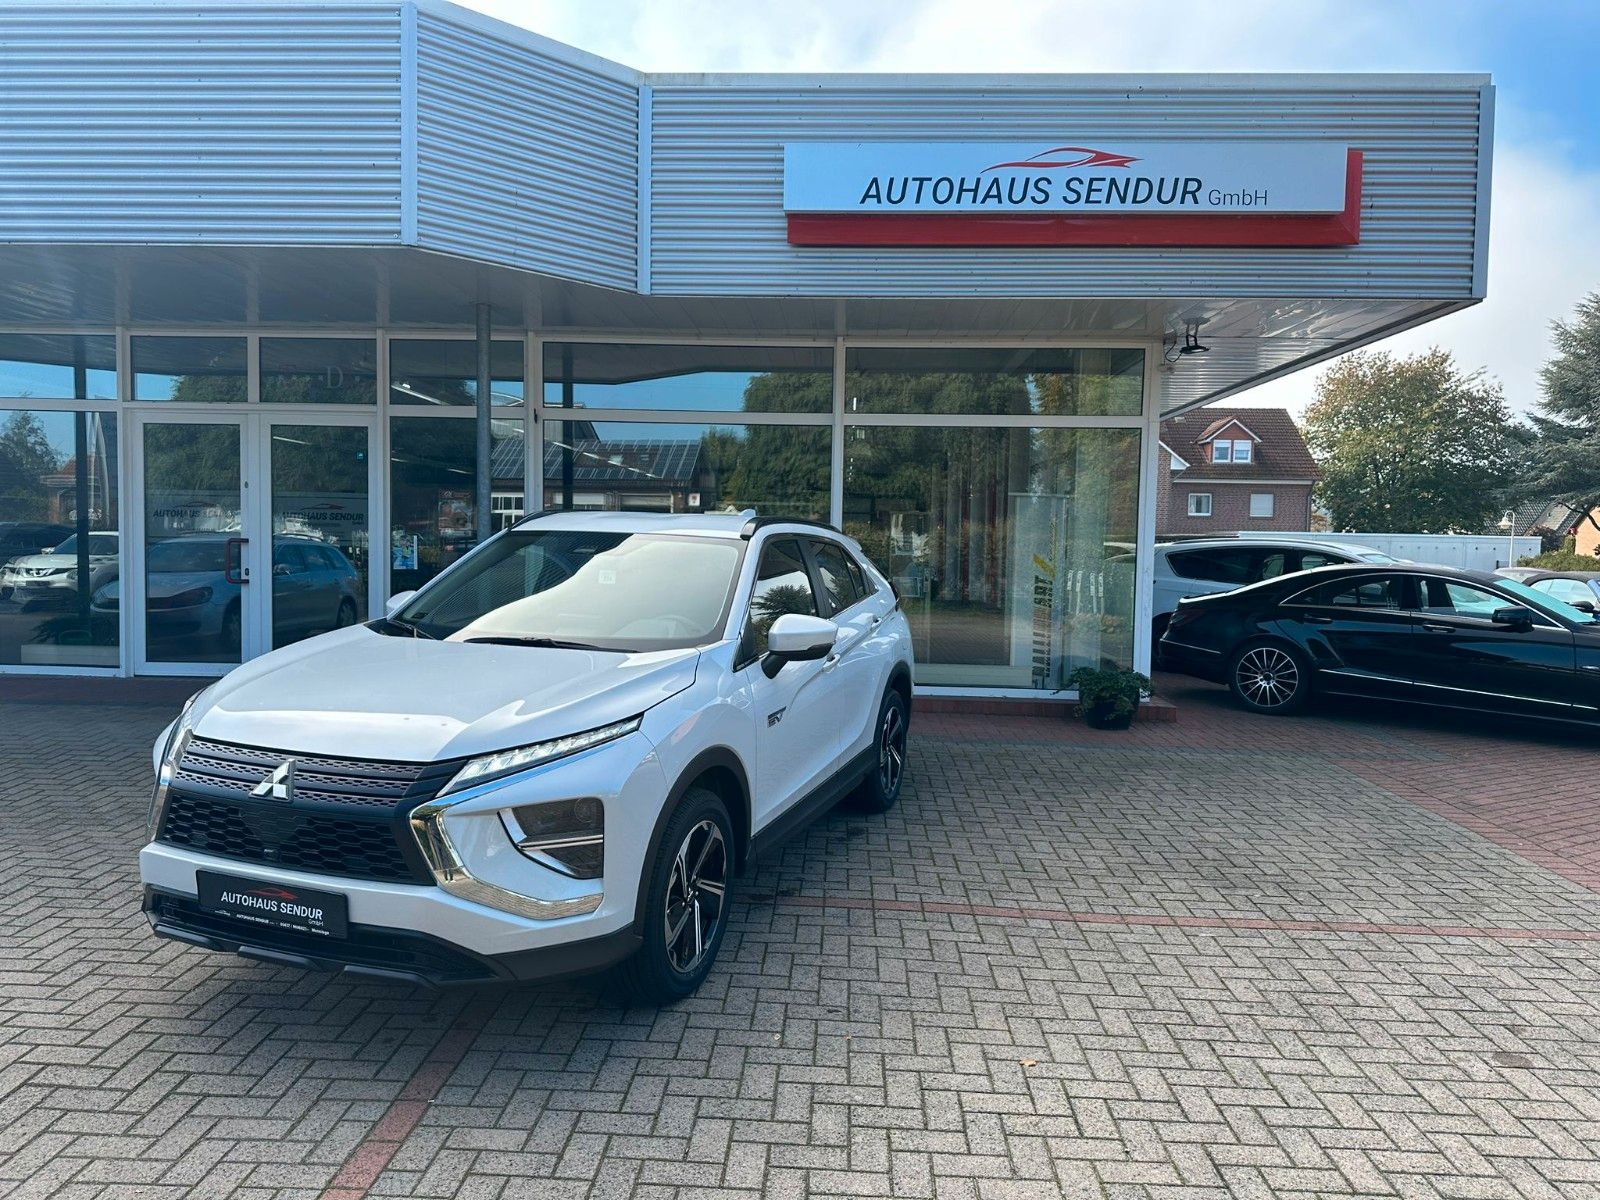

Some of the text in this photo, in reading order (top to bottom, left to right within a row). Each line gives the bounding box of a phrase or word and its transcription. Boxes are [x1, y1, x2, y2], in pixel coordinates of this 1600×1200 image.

[860, 177, 1268, 206] AUTOHAUS SENDUR GmbH
[329, 512, 364, 521] SENDUR
[221, 891, 323, 920] AUTOHAUS SENDUR
